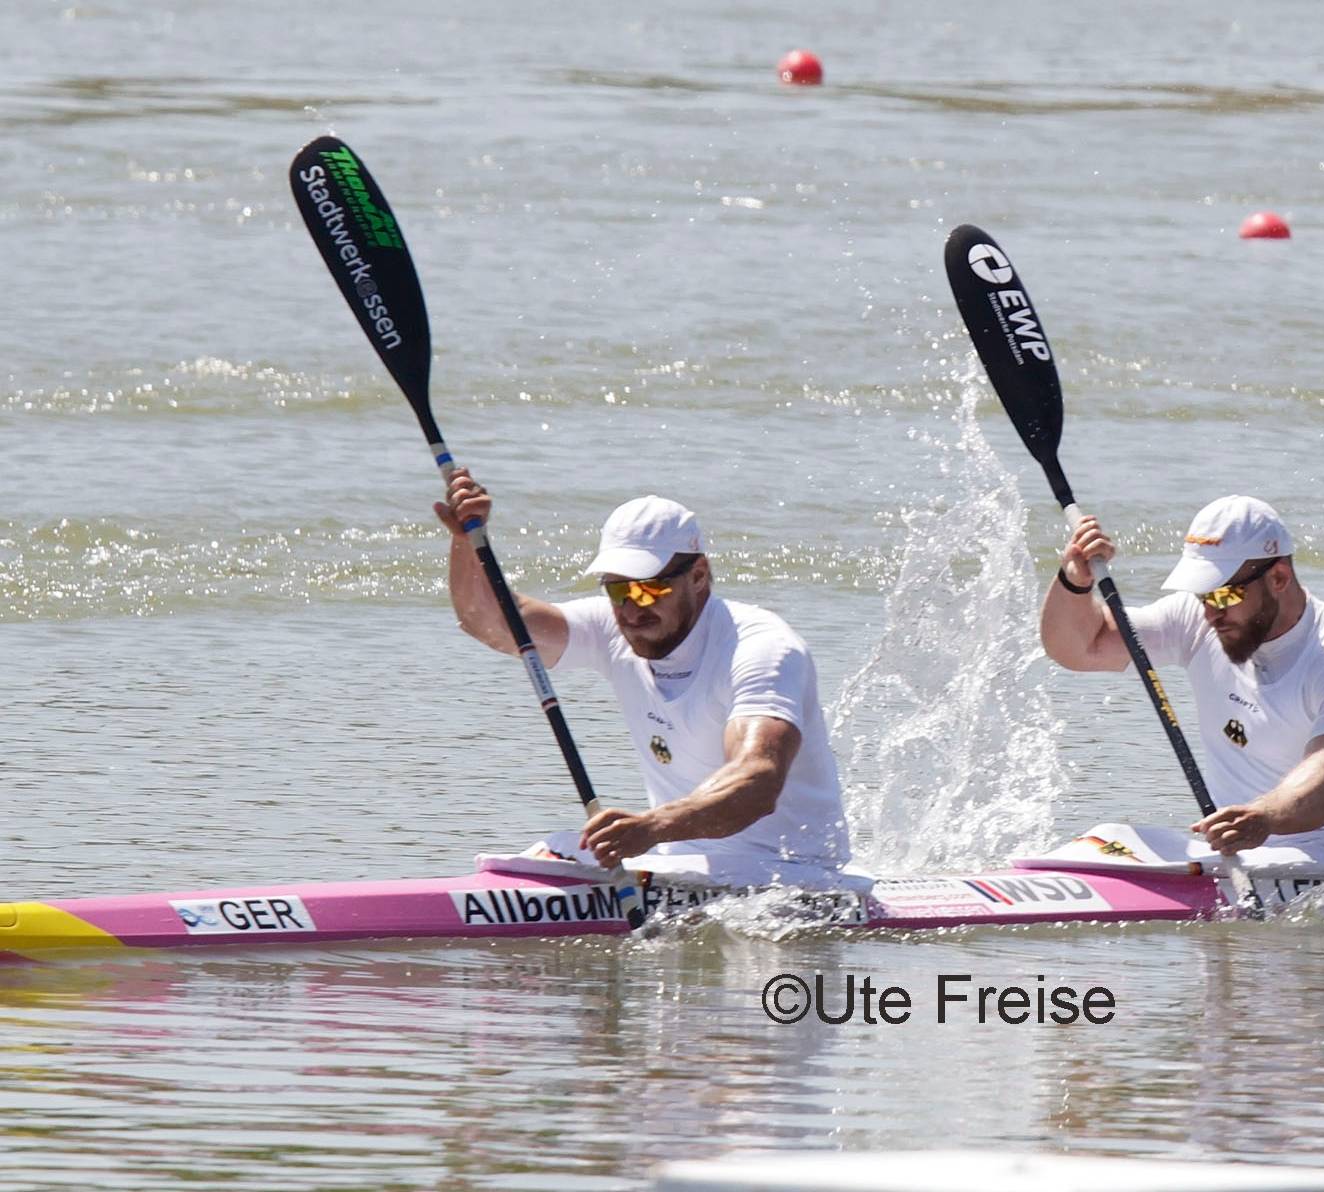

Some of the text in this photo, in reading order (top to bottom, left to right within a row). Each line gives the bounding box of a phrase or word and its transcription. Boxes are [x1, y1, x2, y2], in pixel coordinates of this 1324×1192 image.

[997, 289, 1050, 361] EWP
[988, 879, 1094, 902] WSD
[219, 899, 305, 930] GER
